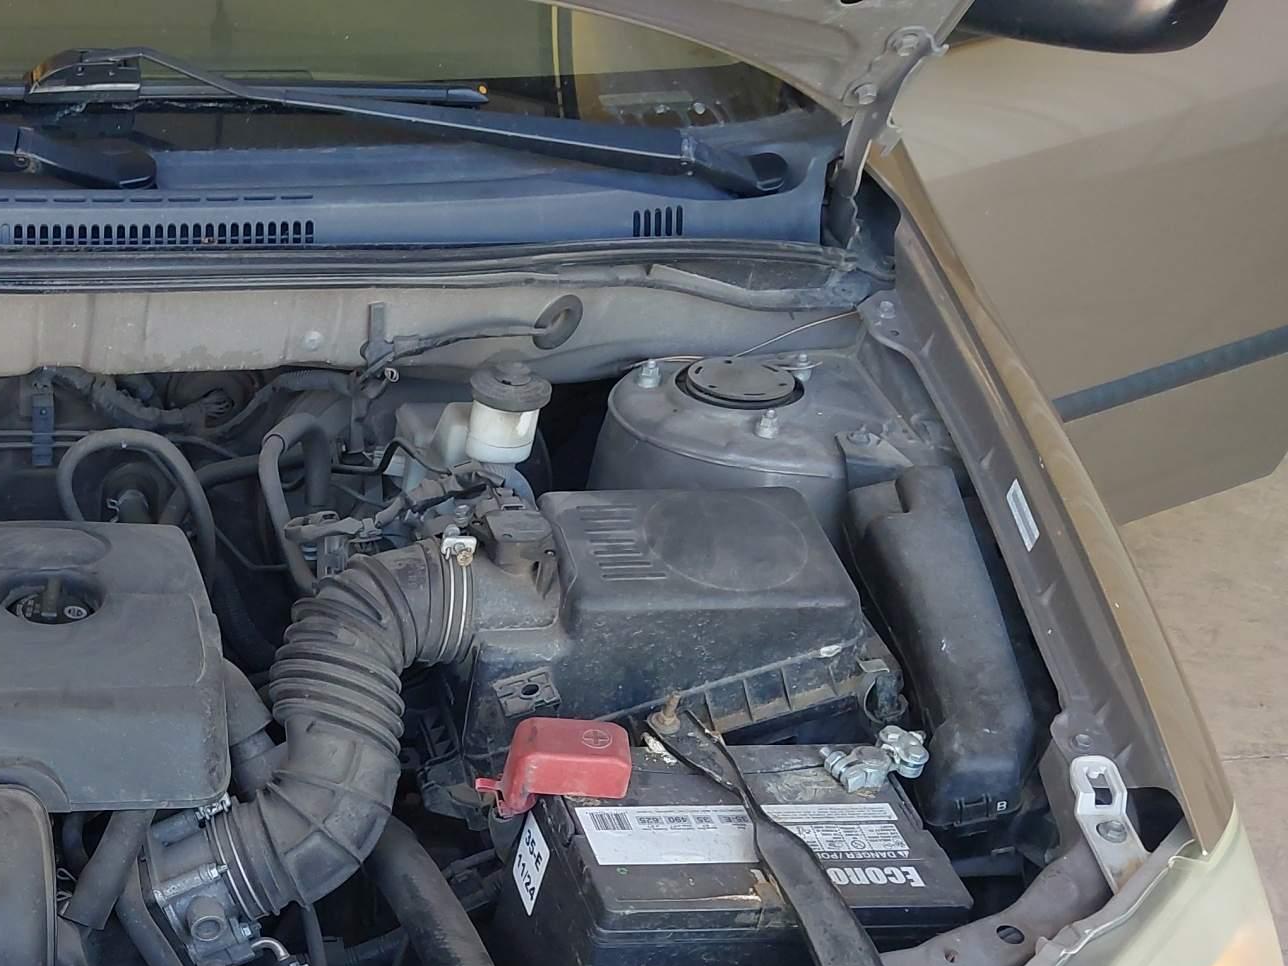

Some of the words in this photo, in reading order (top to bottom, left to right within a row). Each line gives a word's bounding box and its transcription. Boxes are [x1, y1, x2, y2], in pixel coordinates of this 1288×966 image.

[996, 800, 1008, 812] B
[667, 815, 689, 824] 490
[525, 828, 543, 872] 35-E
[845, 850, 897, 860] DANGER
[517, 853, 536, 902] 11/24
[825, 866, 926, 888] Econo
